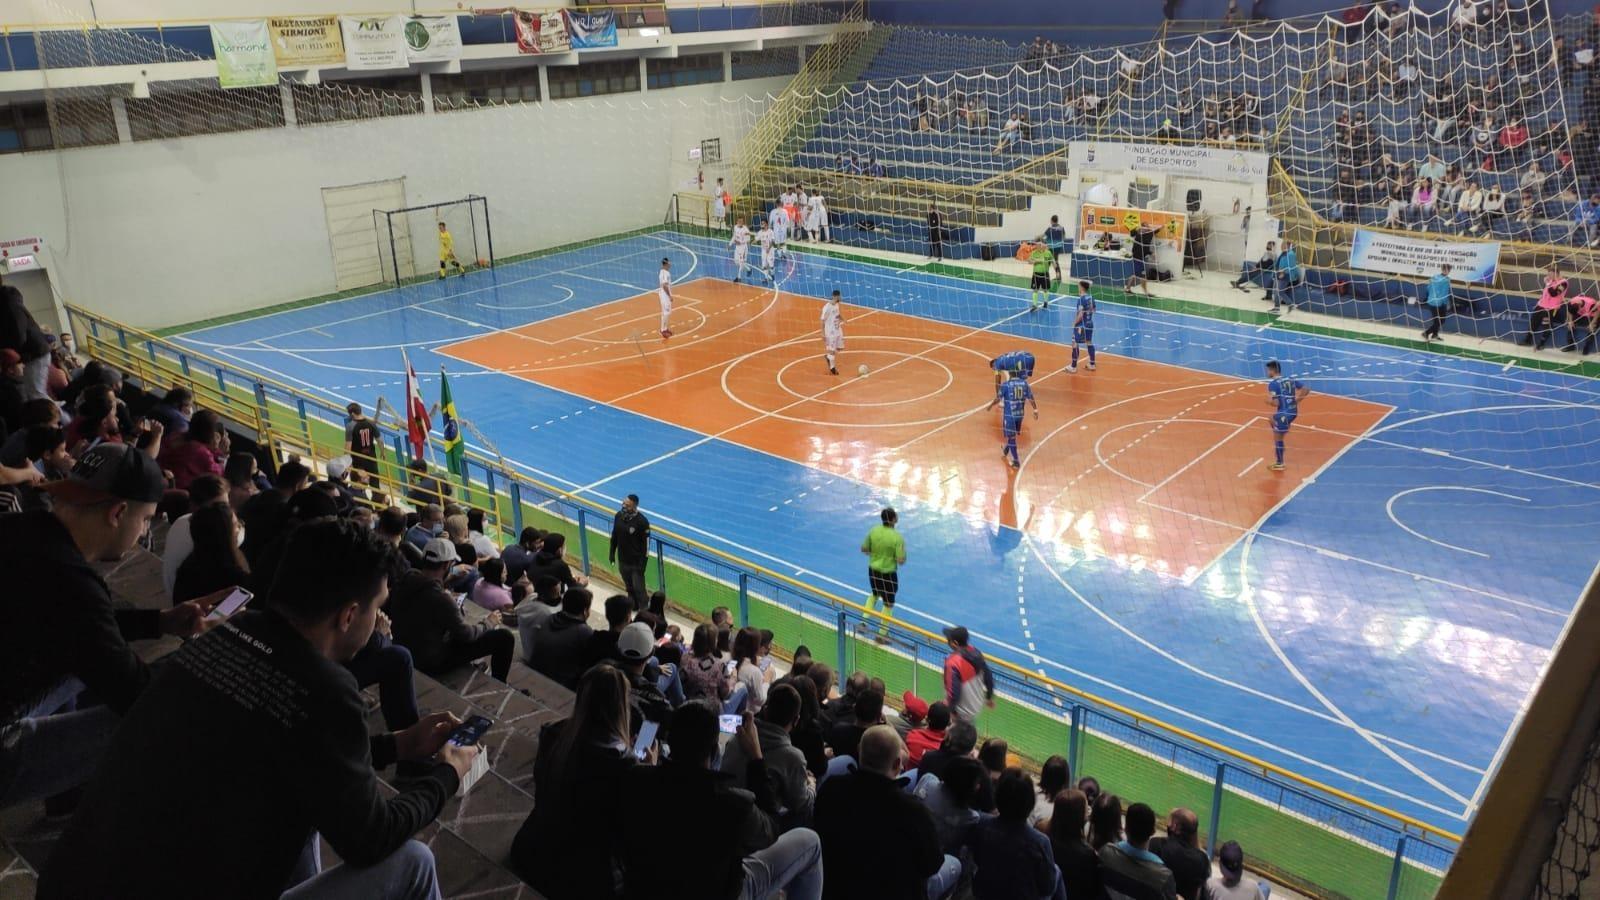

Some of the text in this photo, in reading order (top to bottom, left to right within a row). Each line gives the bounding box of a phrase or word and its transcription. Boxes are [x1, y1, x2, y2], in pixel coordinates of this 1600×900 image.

[271, 18, 335, 28] RESTAURANTE
[280, 27, 326, 37] SIRMIONE
[1169, 148, 1212, 158] MUNICIPAL
[1014, 386, 1023, 400] 10
[239, 632, 253, 643] LIKE
[253, 640, 273, 654] GOLD
